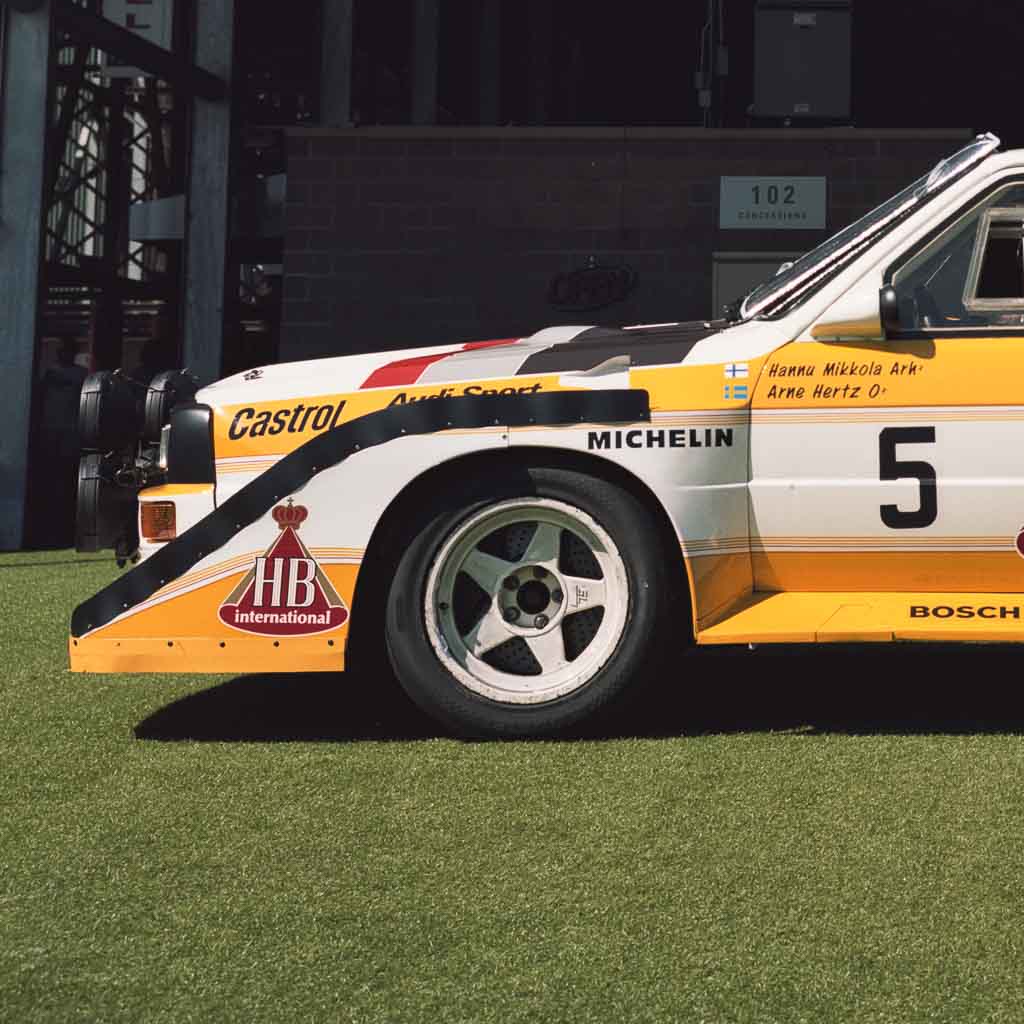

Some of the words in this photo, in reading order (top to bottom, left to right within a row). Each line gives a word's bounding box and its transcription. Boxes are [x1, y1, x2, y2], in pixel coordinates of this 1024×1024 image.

[751, 184, 795, 205] 102
[768, 363, 816, 377] Hannu
[823, 361, 882, 376] Mikkola
[767, 384, 805, 399] Arne
[812, 384, 861, 398] Hertz
[228, 400, 347, 440] Castrol
[587, 428, 733, 449] MICHELIN
[879, 426, 937, 529] 5
[252, 557, 317, 607] HB
[234, 609, 331, 625] international
[909, 606, 1021, 619] BOSCH
